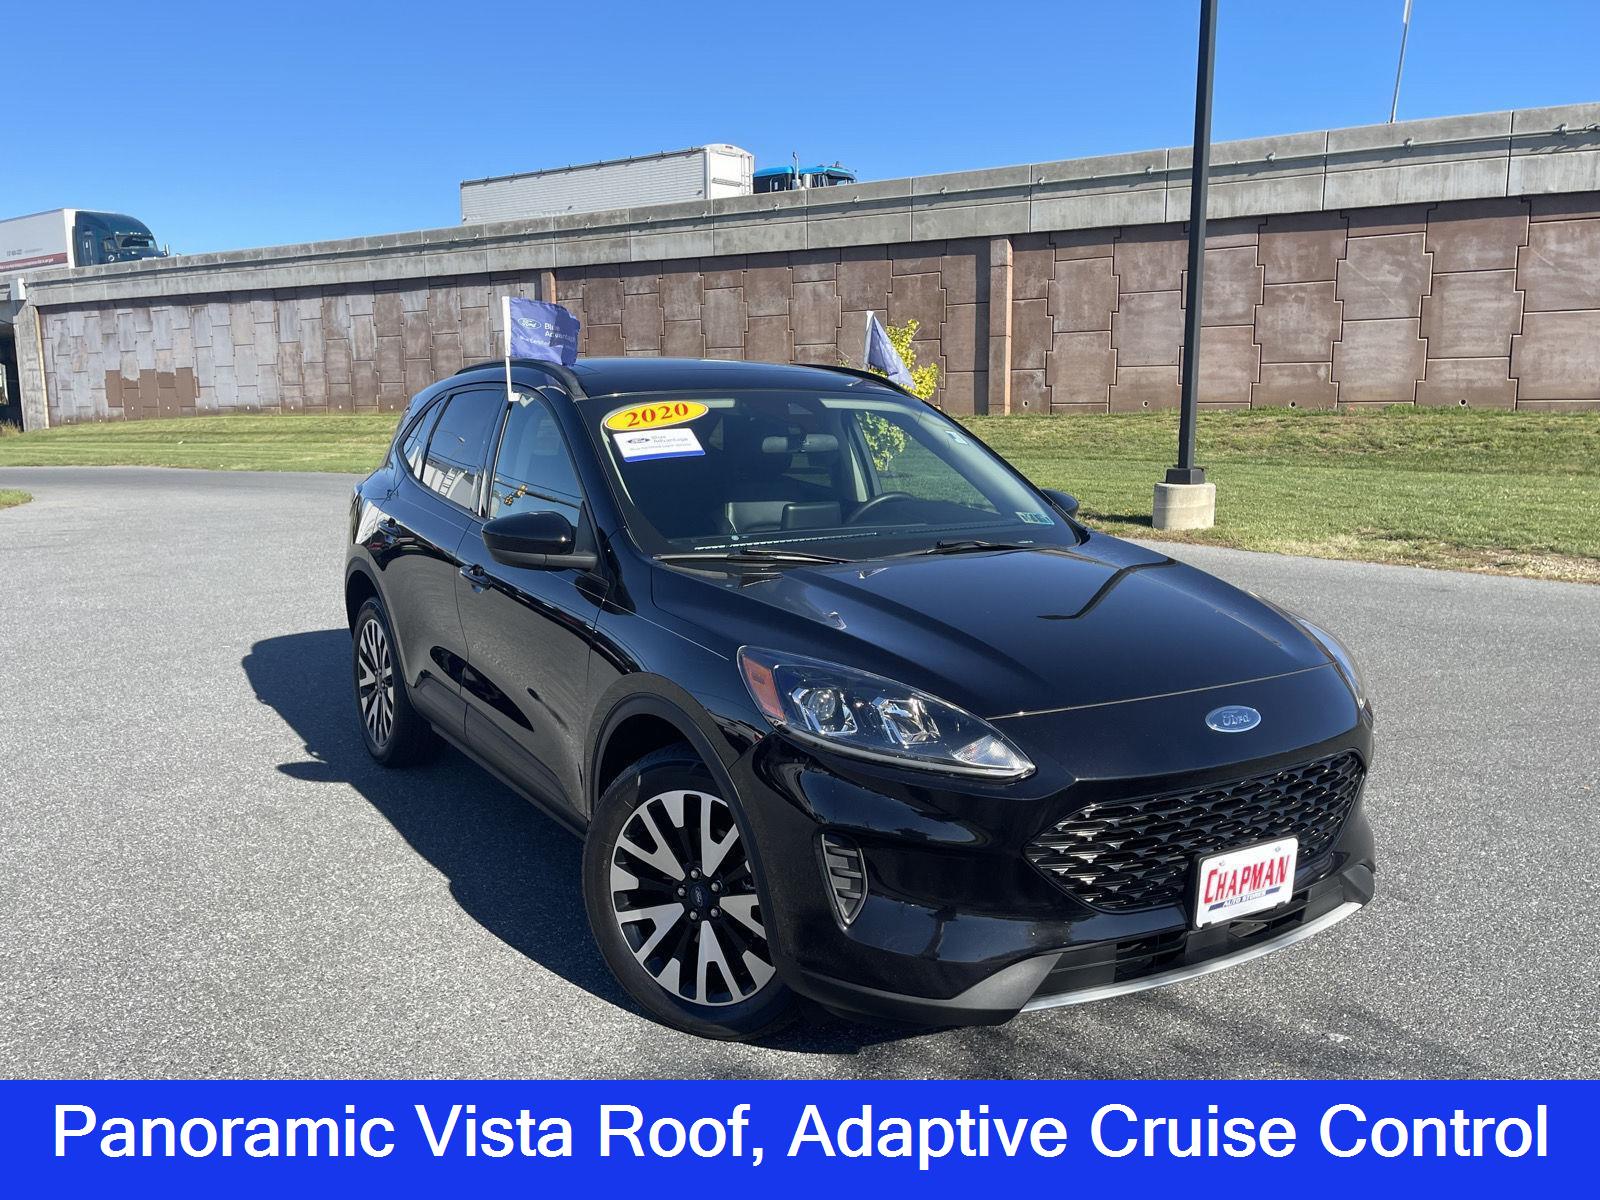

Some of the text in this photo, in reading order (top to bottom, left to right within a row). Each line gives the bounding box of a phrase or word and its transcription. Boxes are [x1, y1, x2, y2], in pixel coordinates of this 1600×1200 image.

[624, 402, 689, 428] 2020
[1219, 709, 1252, 727] Ford
[1203, 853, 1291, 904] CHAPMAN
